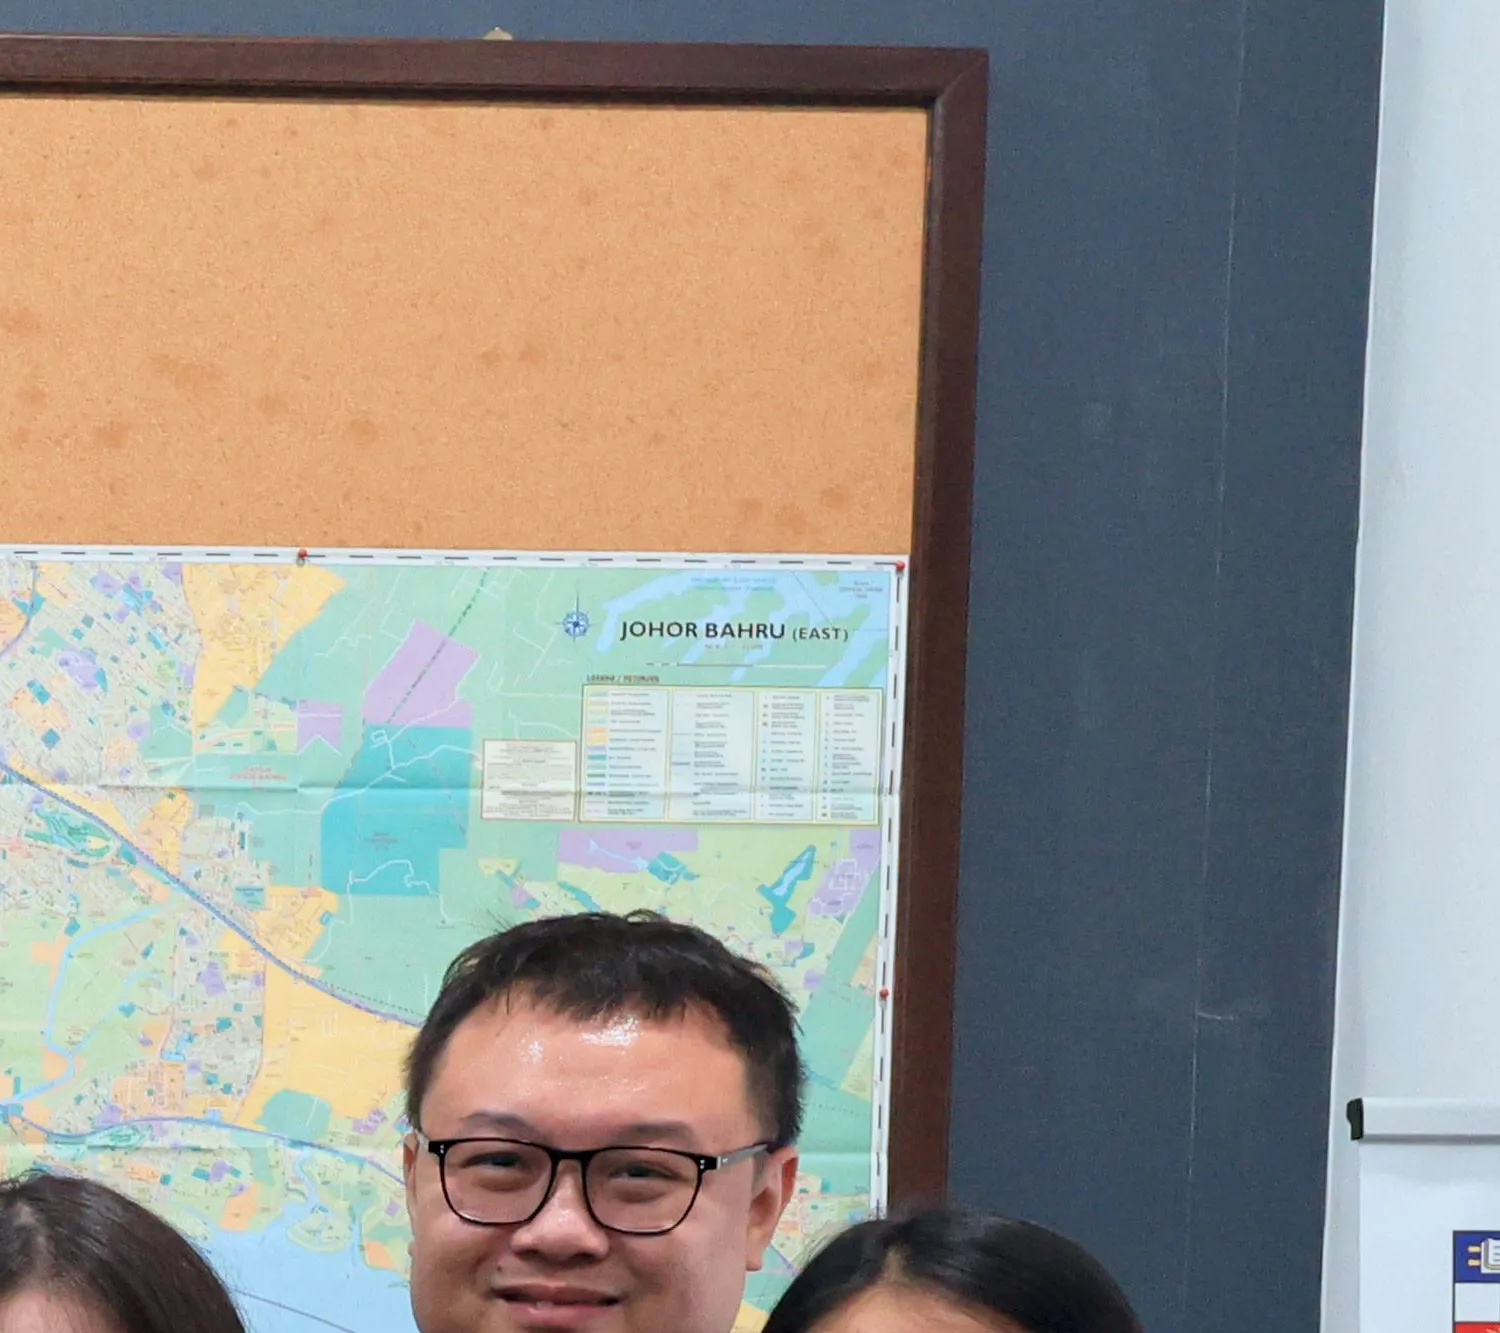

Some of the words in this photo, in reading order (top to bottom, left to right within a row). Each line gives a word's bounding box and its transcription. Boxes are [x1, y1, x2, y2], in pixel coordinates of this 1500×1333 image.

[620, 621, 698, 642] JOHOR
[704, 622, 786, 640] BAHRU
[792, 626, 849, 643] (EAST)
